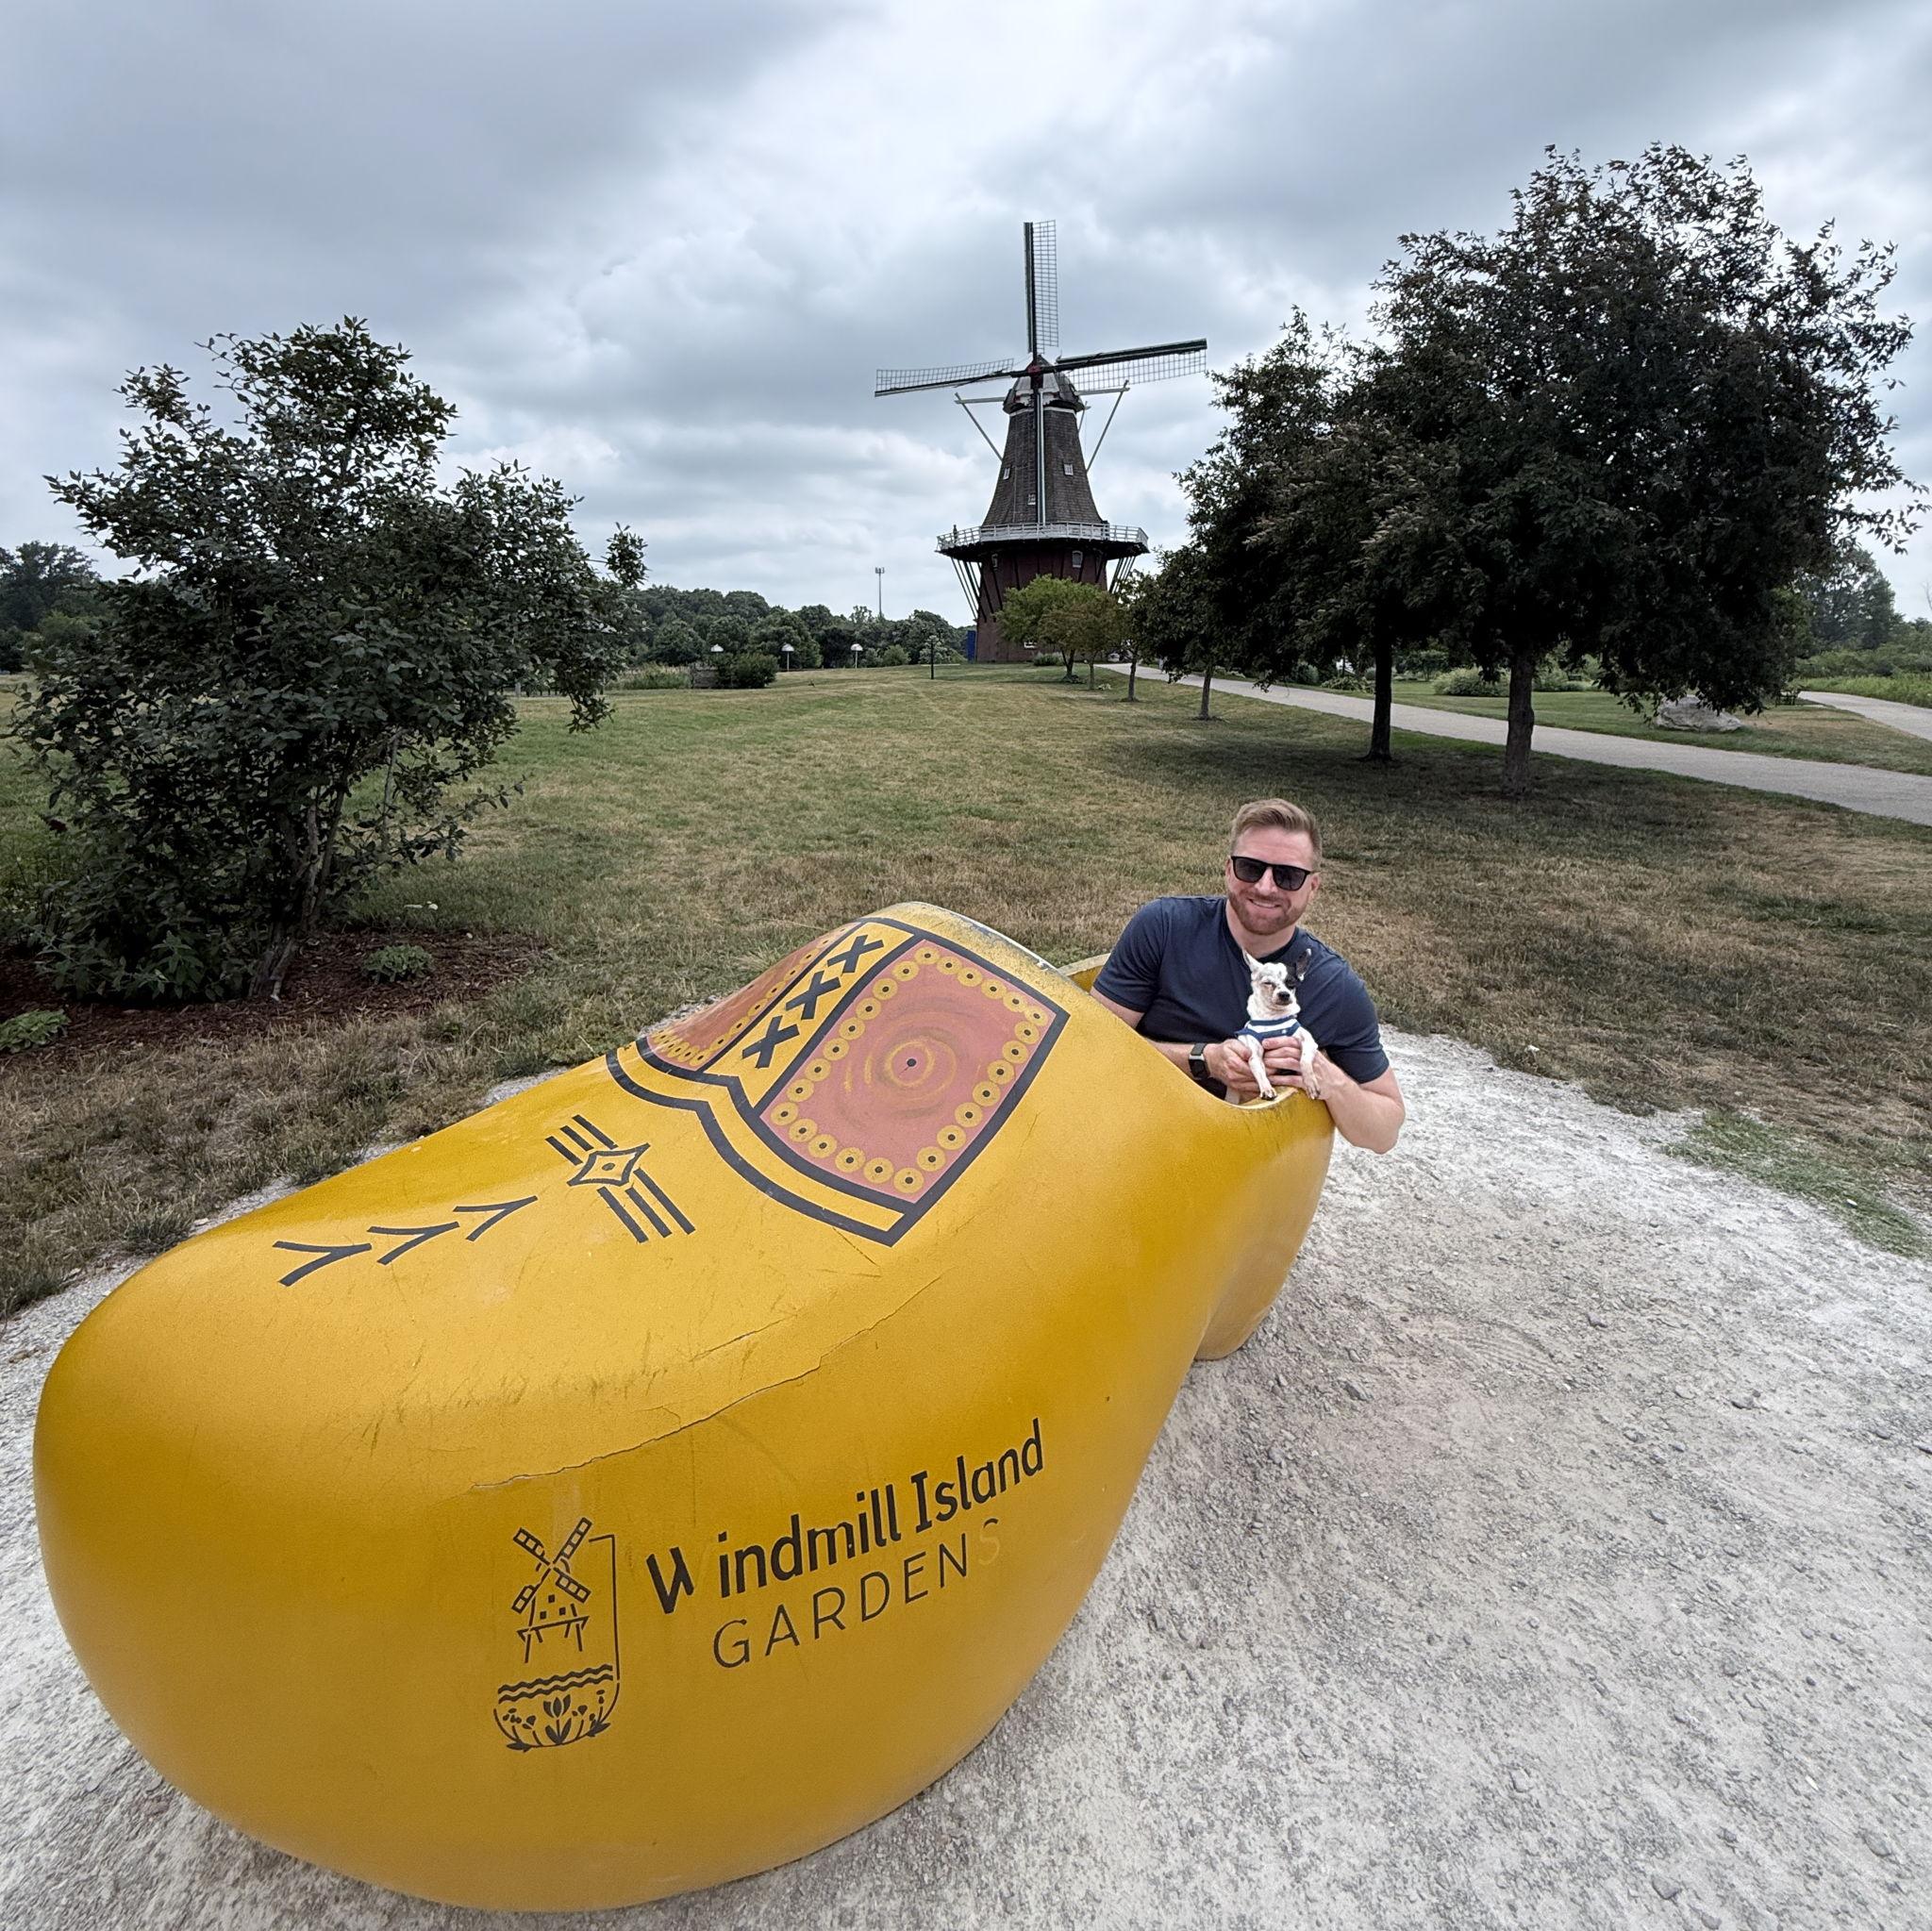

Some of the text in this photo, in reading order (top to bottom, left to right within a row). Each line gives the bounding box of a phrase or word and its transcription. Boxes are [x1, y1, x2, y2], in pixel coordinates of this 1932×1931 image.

[646, 1418, 1044, 1615] Windmill Island
[713, 1518, 1001, 1669] GARDENS
